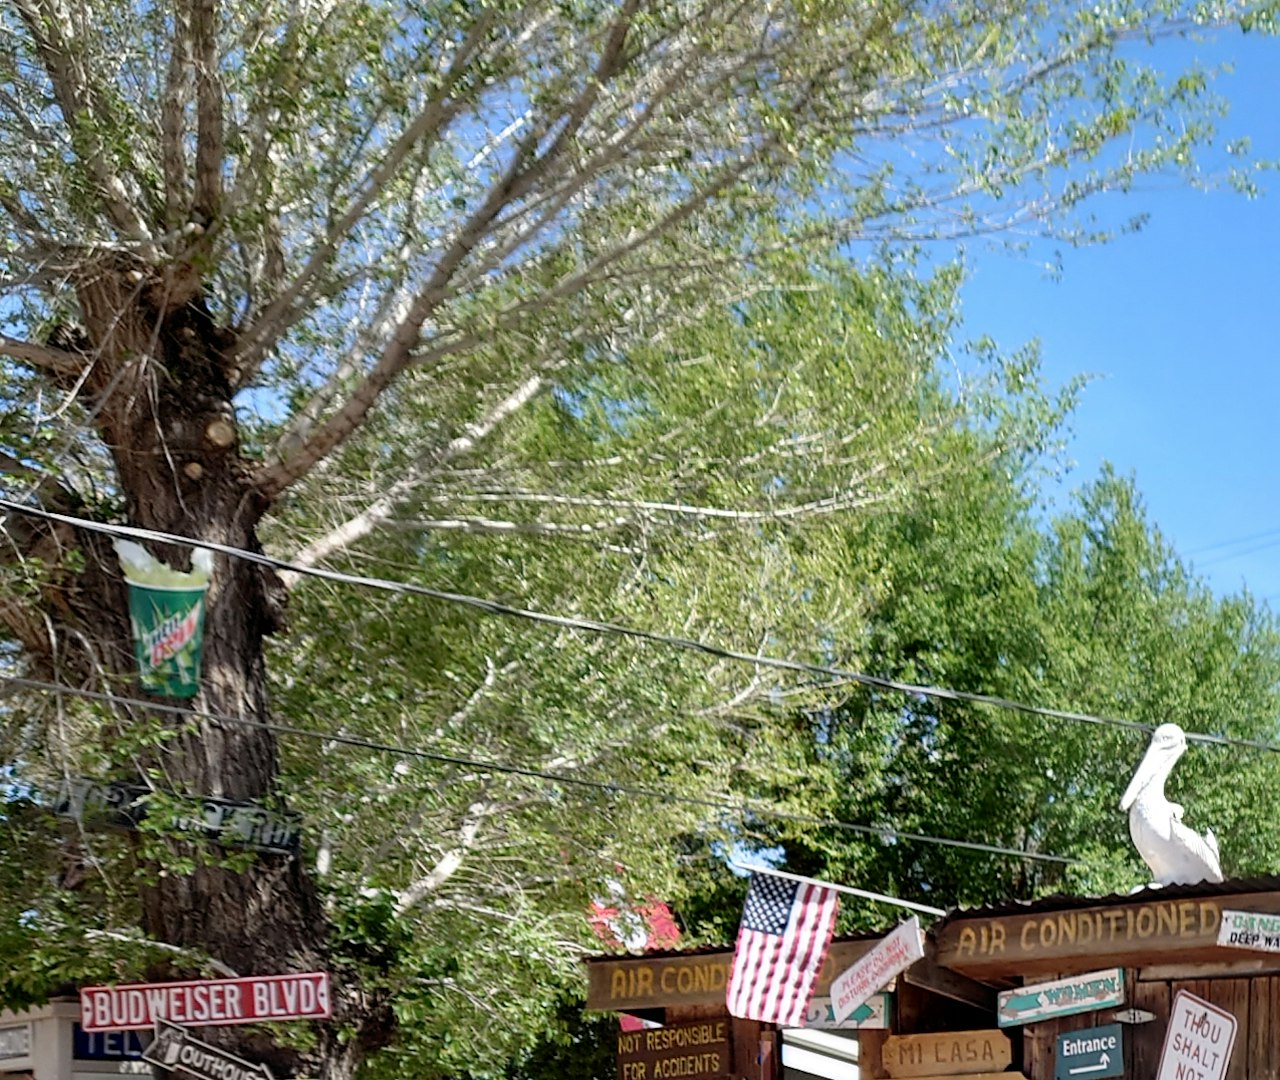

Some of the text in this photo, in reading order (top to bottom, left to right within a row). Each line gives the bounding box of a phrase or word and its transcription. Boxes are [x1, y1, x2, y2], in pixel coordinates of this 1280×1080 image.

[957, 902, 1221, 956] AIR CONDITIONED
[1230, 932, 1260, 946] DEEP
[610, 965, 654, 1000] AIR
[93, 978, 318, 1027] BUDWEISER BLVD
[618, 1022, 726, 1055] NOT RESPONSIBLE
[1184, 1010, 1221, 1044] THOU
[899, 1039, 994, 1066] MI CASA
[1062, 1035, 1117, 1057] Entrance
[1172, 1034, 1220, 1072] SHALT
[653, 1052, 721, 1078] ACCIDENTS
